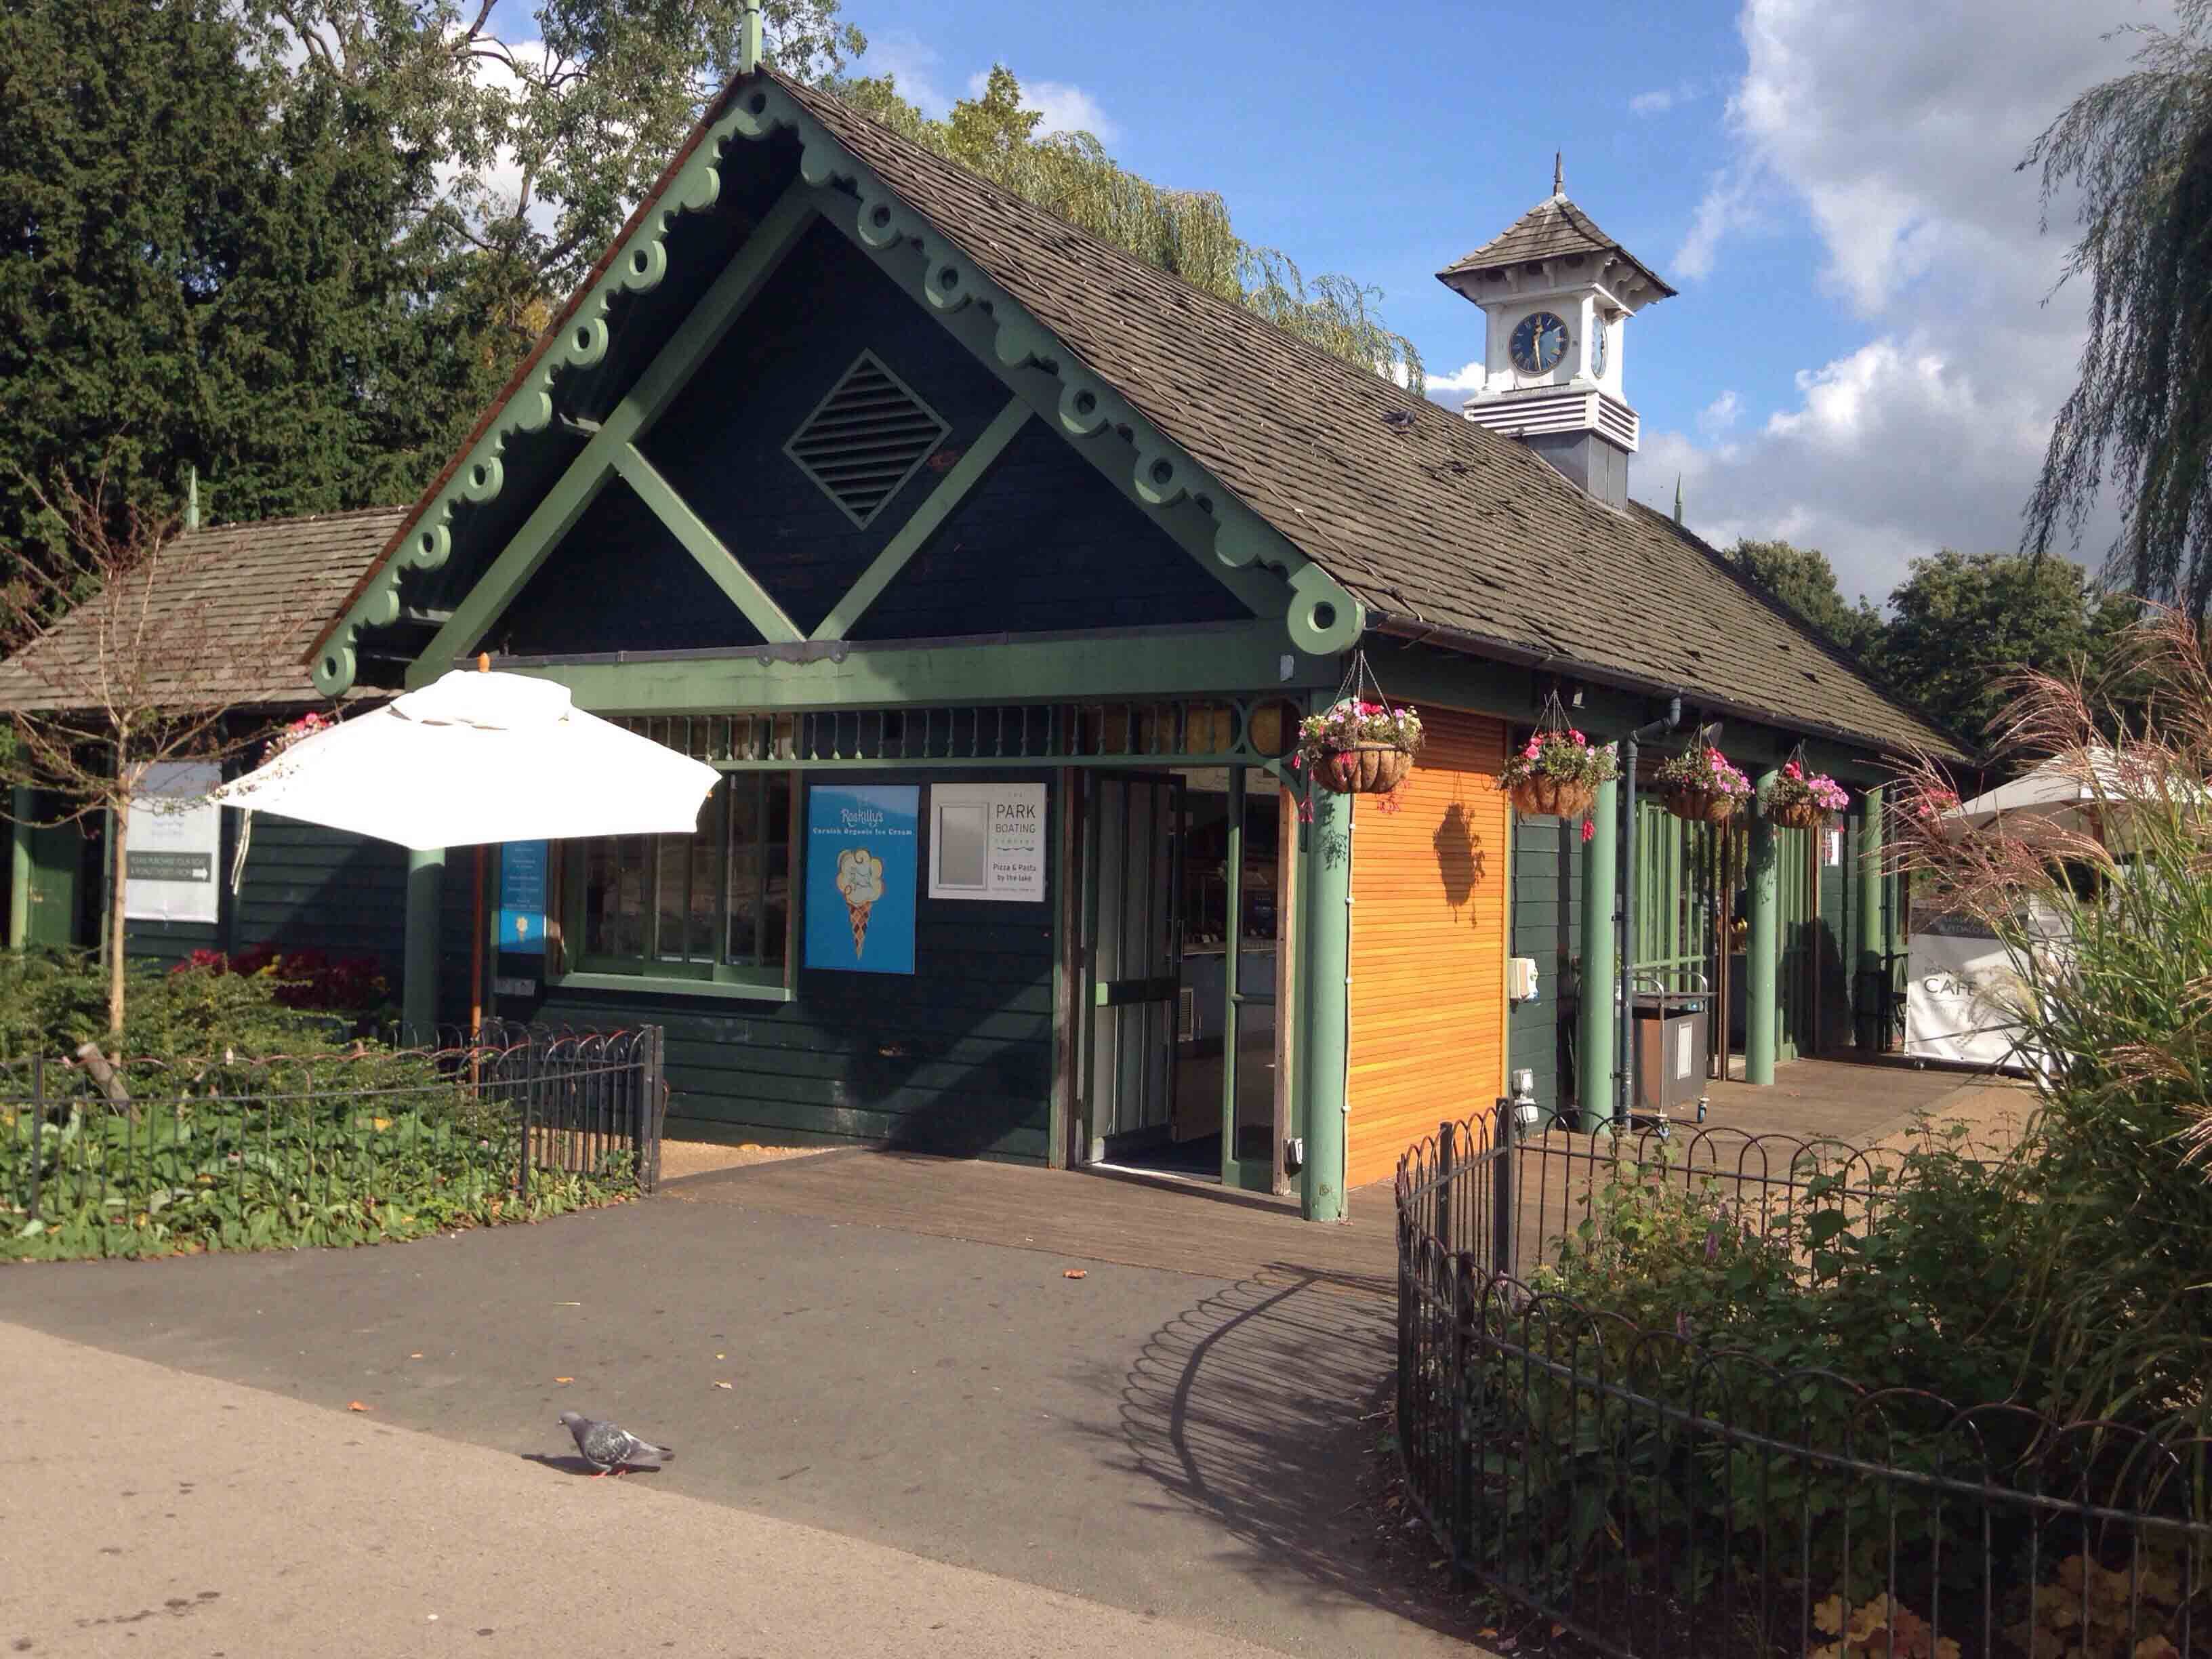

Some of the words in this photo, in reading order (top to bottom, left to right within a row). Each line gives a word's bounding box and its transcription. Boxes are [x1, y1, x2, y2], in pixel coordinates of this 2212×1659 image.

[996, 804, 1036, 819] PARK
[996, 823, 1036, 834] BOATING
[992, 863, 1010, 872] Pizza
[1019, 863, 1036, 872] Pasta
[997, 874, 1005, 883] by
[1006, 874, 1018, 882] the
[1019, 874, 1033, 882] lake
[1923, 977, 1977, 997] CAFE
